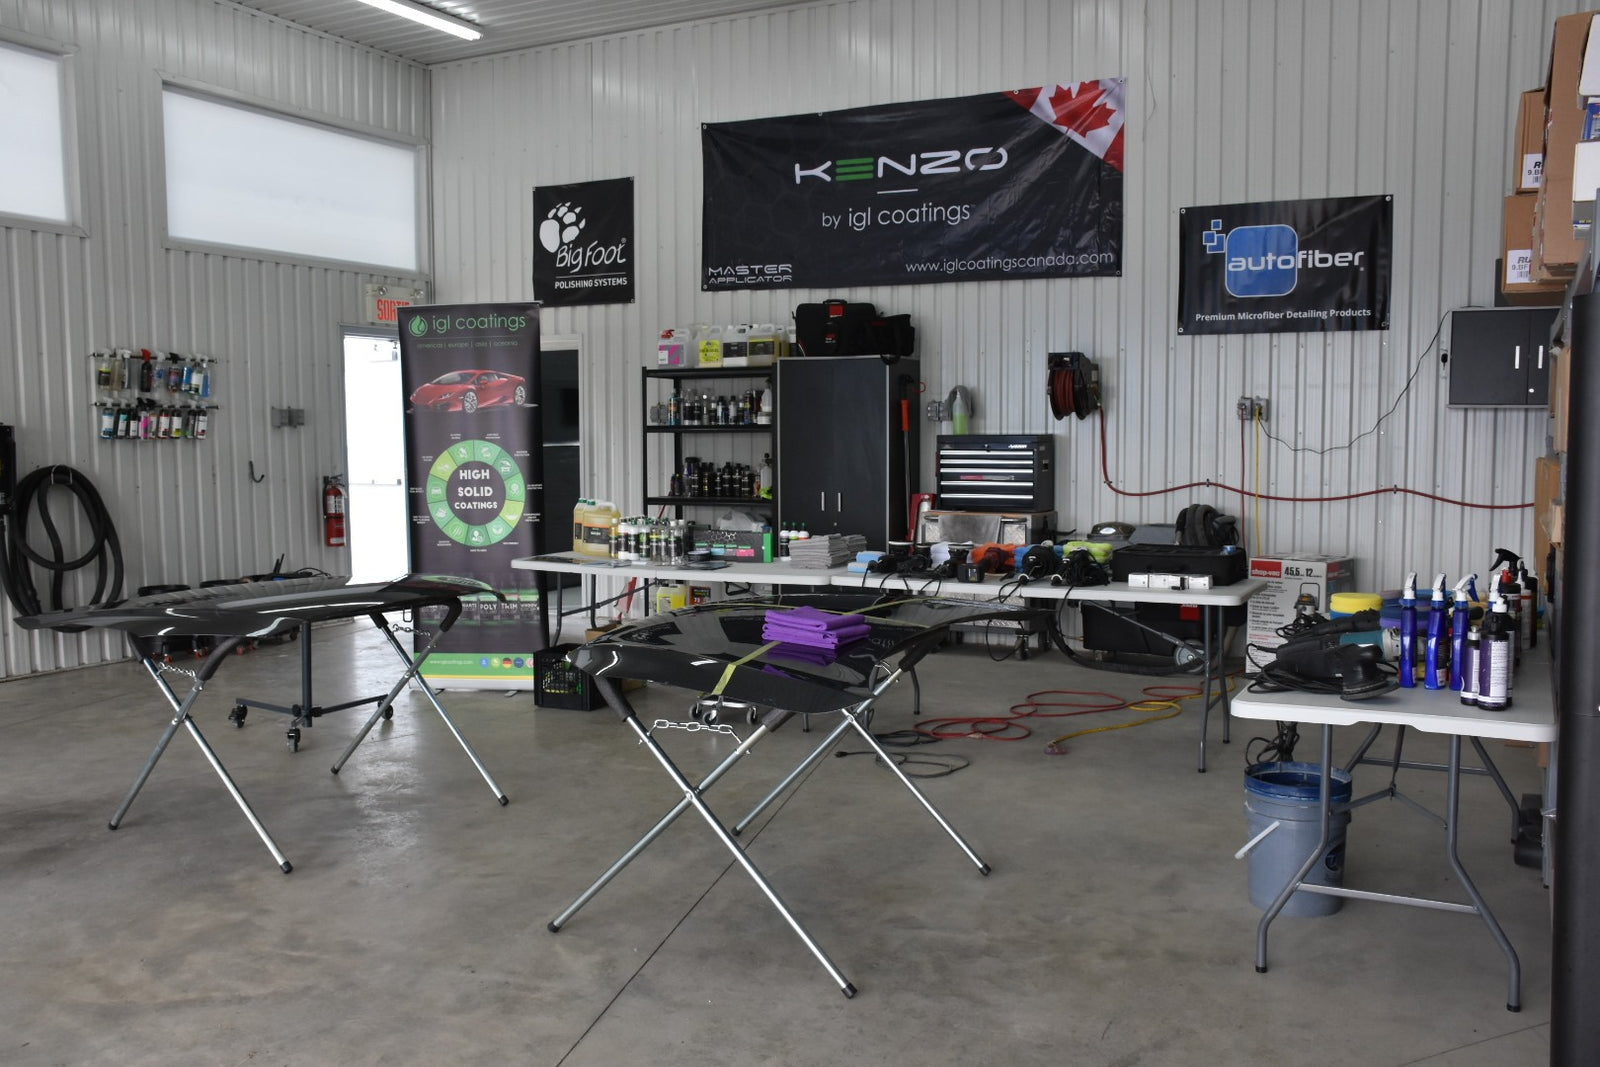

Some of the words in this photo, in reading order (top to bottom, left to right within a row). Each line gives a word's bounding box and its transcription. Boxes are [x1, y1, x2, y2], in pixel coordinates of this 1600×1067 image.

[795, 147, 1008, 184] KENZO
[822, 212, 841, 229] by
[848, 206, 871, 231] igl
[878, 202, 970, 226] coatings
[905, 252, 1114, 275] www.iglcoatingscanada.com
[1228, 250, 1364, 272] autofiber
[708, 264, 792, 277] MASTER
[555, 279, 593, 290] POLISHING
[594, 277, 628, 287] SYSTEMS
[708, 274, 792, 285] APPLICATOR
[1195, 313, 1236, 322] Premium
[1237, 311, 1284, 320] Microfiber
[1286, 309, 1328, 321] Detailing
[1329, 308, 1372, 318] Products
[432, 315, 450, 334] igl
[455, 314, 526, 332] coatings
[459, 469, 490, 480] HIGH
[457, 486, 493, 497] SOLID
[454, 501, 498, 510] COATINGS
[1305, 568, 1314, 577] 12
[480, 602, 498, 610] POLY
